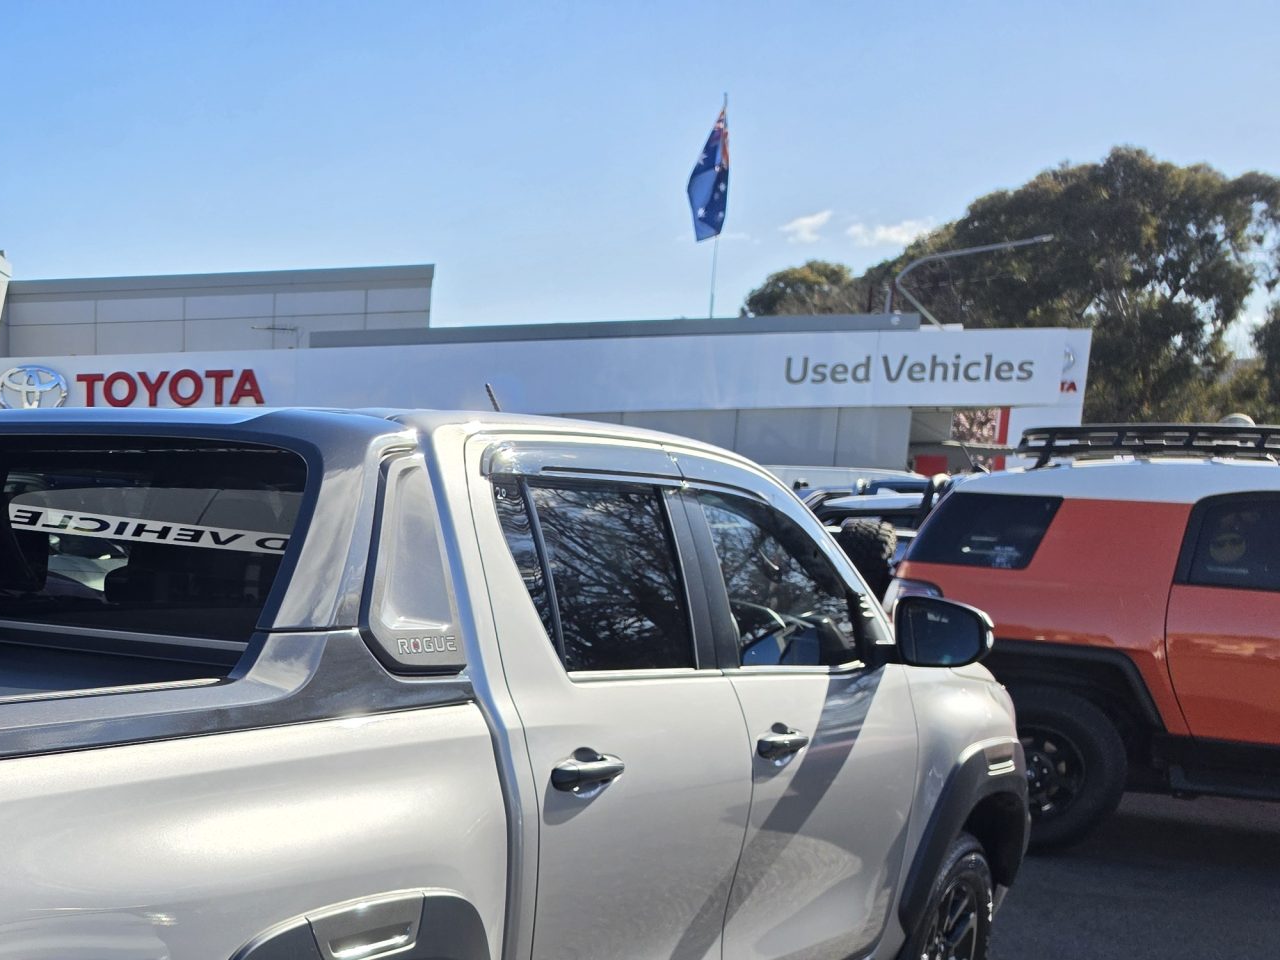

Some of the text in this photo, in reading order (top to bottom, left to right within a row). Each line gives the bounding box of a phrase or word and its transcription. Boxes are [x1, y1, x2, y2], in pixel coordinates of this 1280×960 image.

[784, 353, 1035, 385] Used Vehicles
[76, 369, 265, 407] TOYOTA
[397, 636, 457, 654] ROGUE
